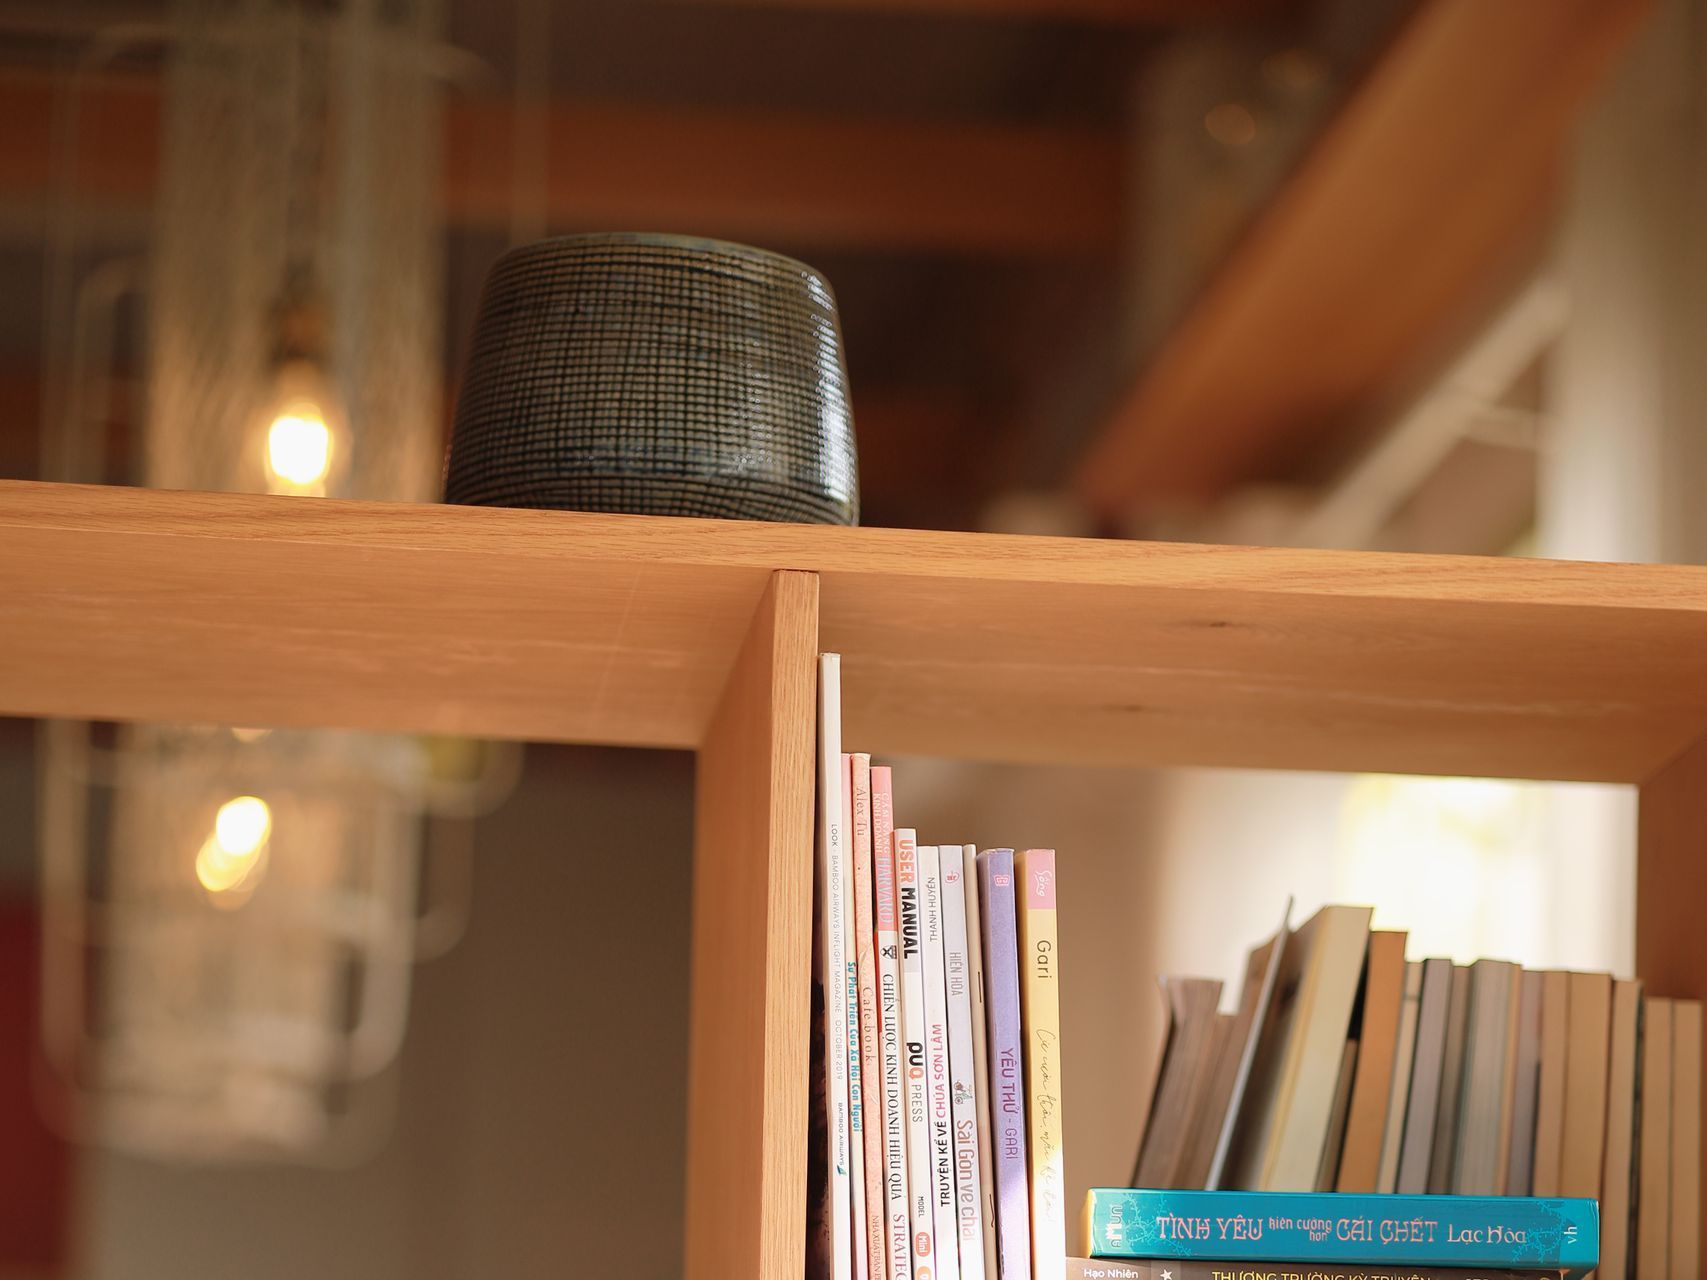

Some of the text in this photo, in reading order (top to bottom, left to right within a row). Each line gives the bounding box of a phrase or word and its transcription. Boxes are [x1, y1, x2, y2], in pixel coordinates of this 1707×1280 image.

[855, 787, 865, 818] Alex
[879, 856, 893, 924] HARVARD
[899, 839, 919, 959] USER MANUAL
[929, 909, 937, 942] THANH
[1036, 940, 1052, 979] Gari
[882, 1015, 897, 1047] LƯỢC
[931, 1024, 943, 1052] LÂM
[887, 1051, 897, 1085] KINH
[933, 1057, 944, 1082] SƠN
[1000, 1047, 1015, 1078] YÊU
[887, 1088, 900, 1135] DOANH
[911, 1085, 923, 1122] PRESS
[887, 1139, 904, 1171] HIỆU
[1006, 1129, 1018, 1159] GARI
[958, 1149, 976, 1180] Gòn
[938, 1160, 951, 1208] TRUYỆN
[918, 1234, 928, 1255] Mini
[1156, 1213, 1211, 1240] TÌNH
[1216, 1215, 1264, 1241] YÊU
[1336, 1216, 1373, 1242] CÁI
[1380, 1216, 1438, 1245] CHẾT
[1447, 1224, 1484, 1245] Lạc
[1564, 1226, 1578, 1244] vh
[1083, 1268, 1139, 1280] Hạo Nhiên
